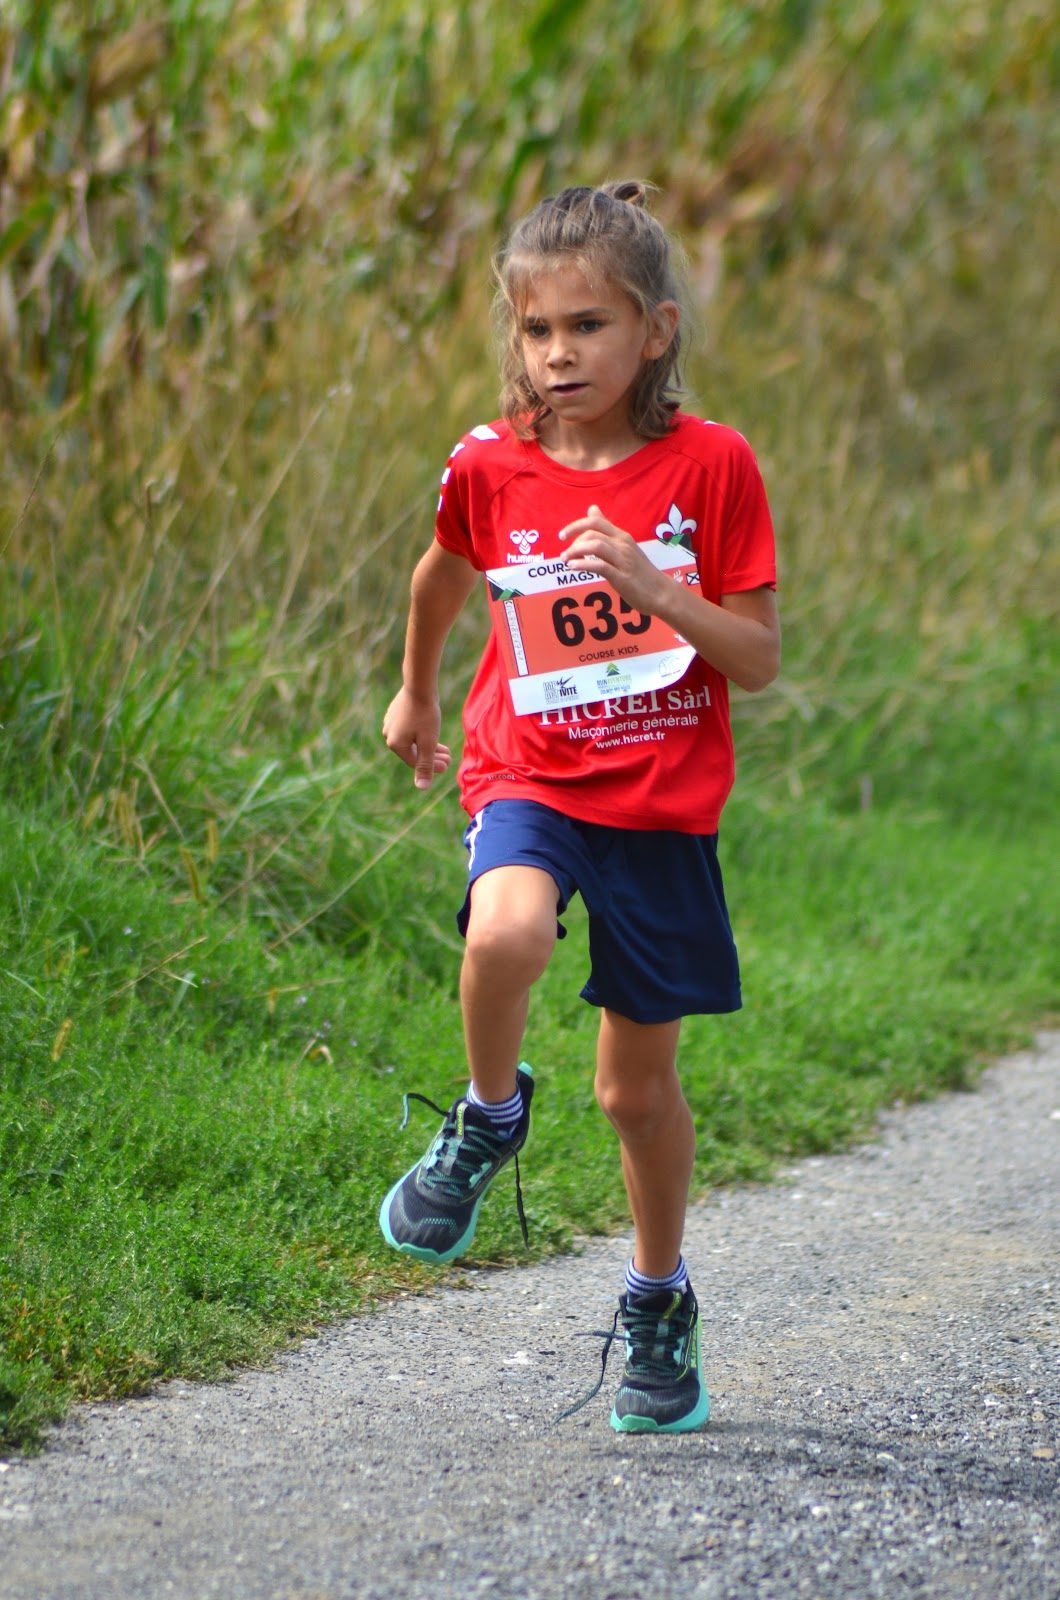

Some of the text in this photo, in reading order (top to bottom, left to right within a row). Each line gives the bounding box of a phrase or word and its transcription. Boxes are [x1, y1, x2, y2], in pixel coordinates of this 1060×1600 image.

[507, 552, 544, 564] hummel
[552, 591, 651, 647] 635
[579, 645, 639, 662] COURSE KIDS
[667, 686, 711, 710] Sàrl
[568, 713, 699, 740] Maçonnerie générale
[595, 731, 666, 749] www.hicret.fr
